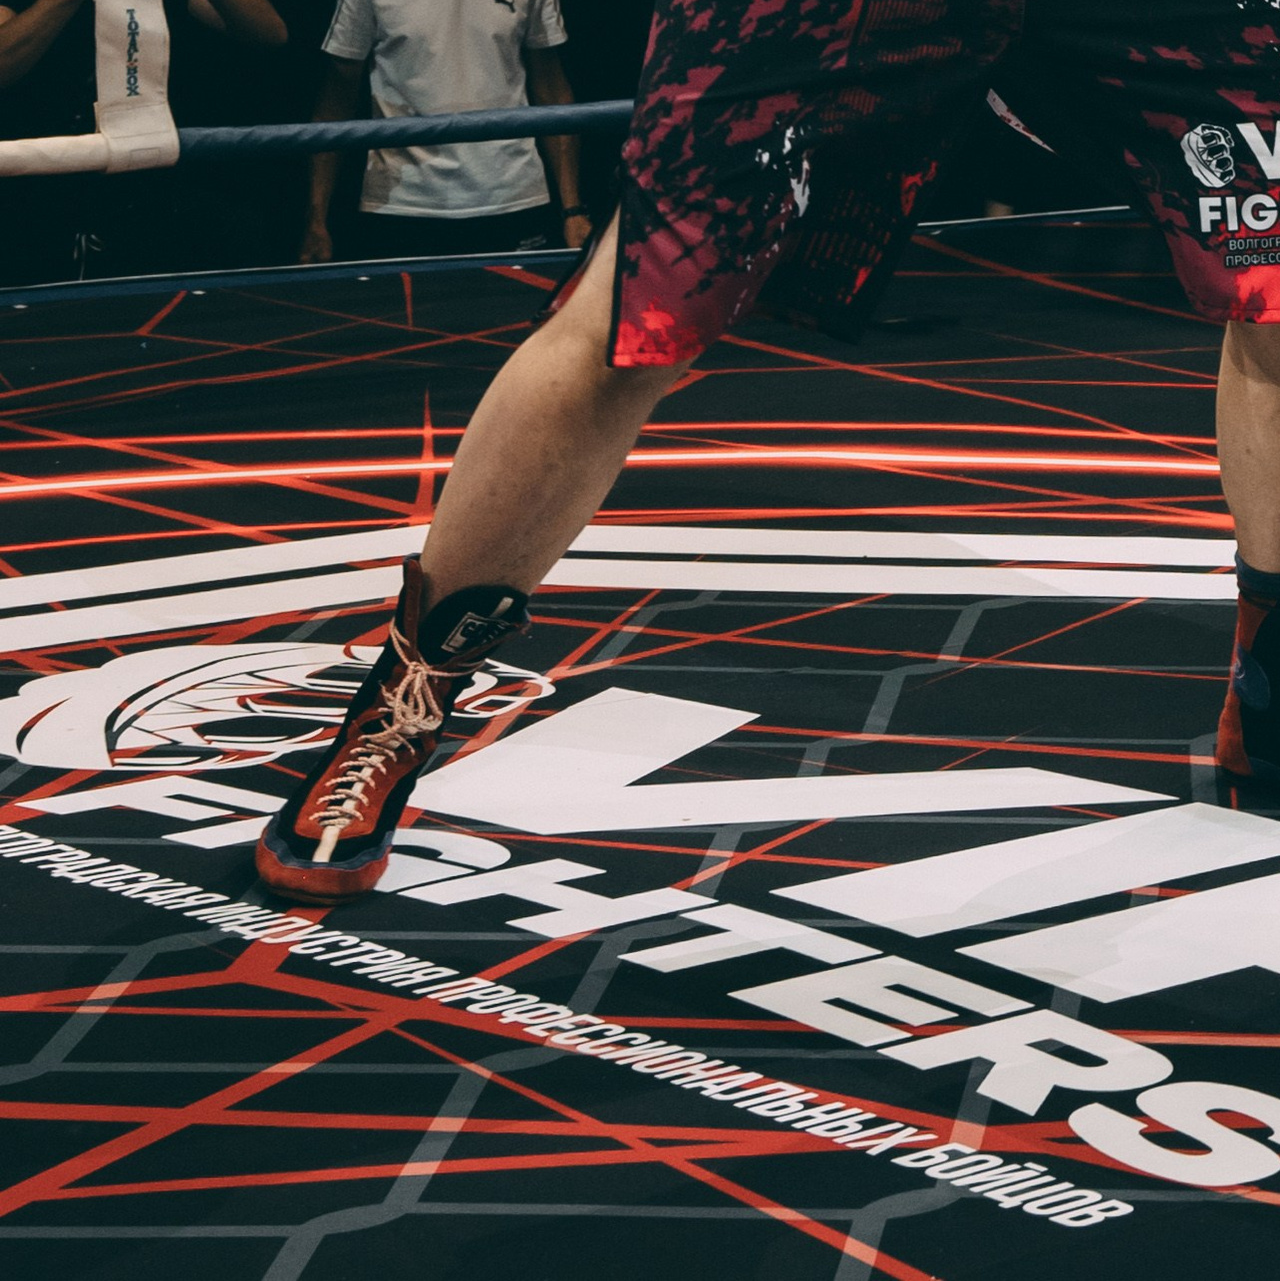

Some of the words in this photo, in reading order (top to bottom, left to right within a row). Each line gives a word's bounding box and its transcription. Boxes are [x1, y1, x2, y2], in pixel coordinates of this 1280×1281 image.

[182, 901, 461, 988] ИНДУСТРИЯ
[411, 976, 939, 1156] ПРОФЕССИОНАЛЬНЫХ
[889, 1142, 1135, 1228] БОЙЦОВ
